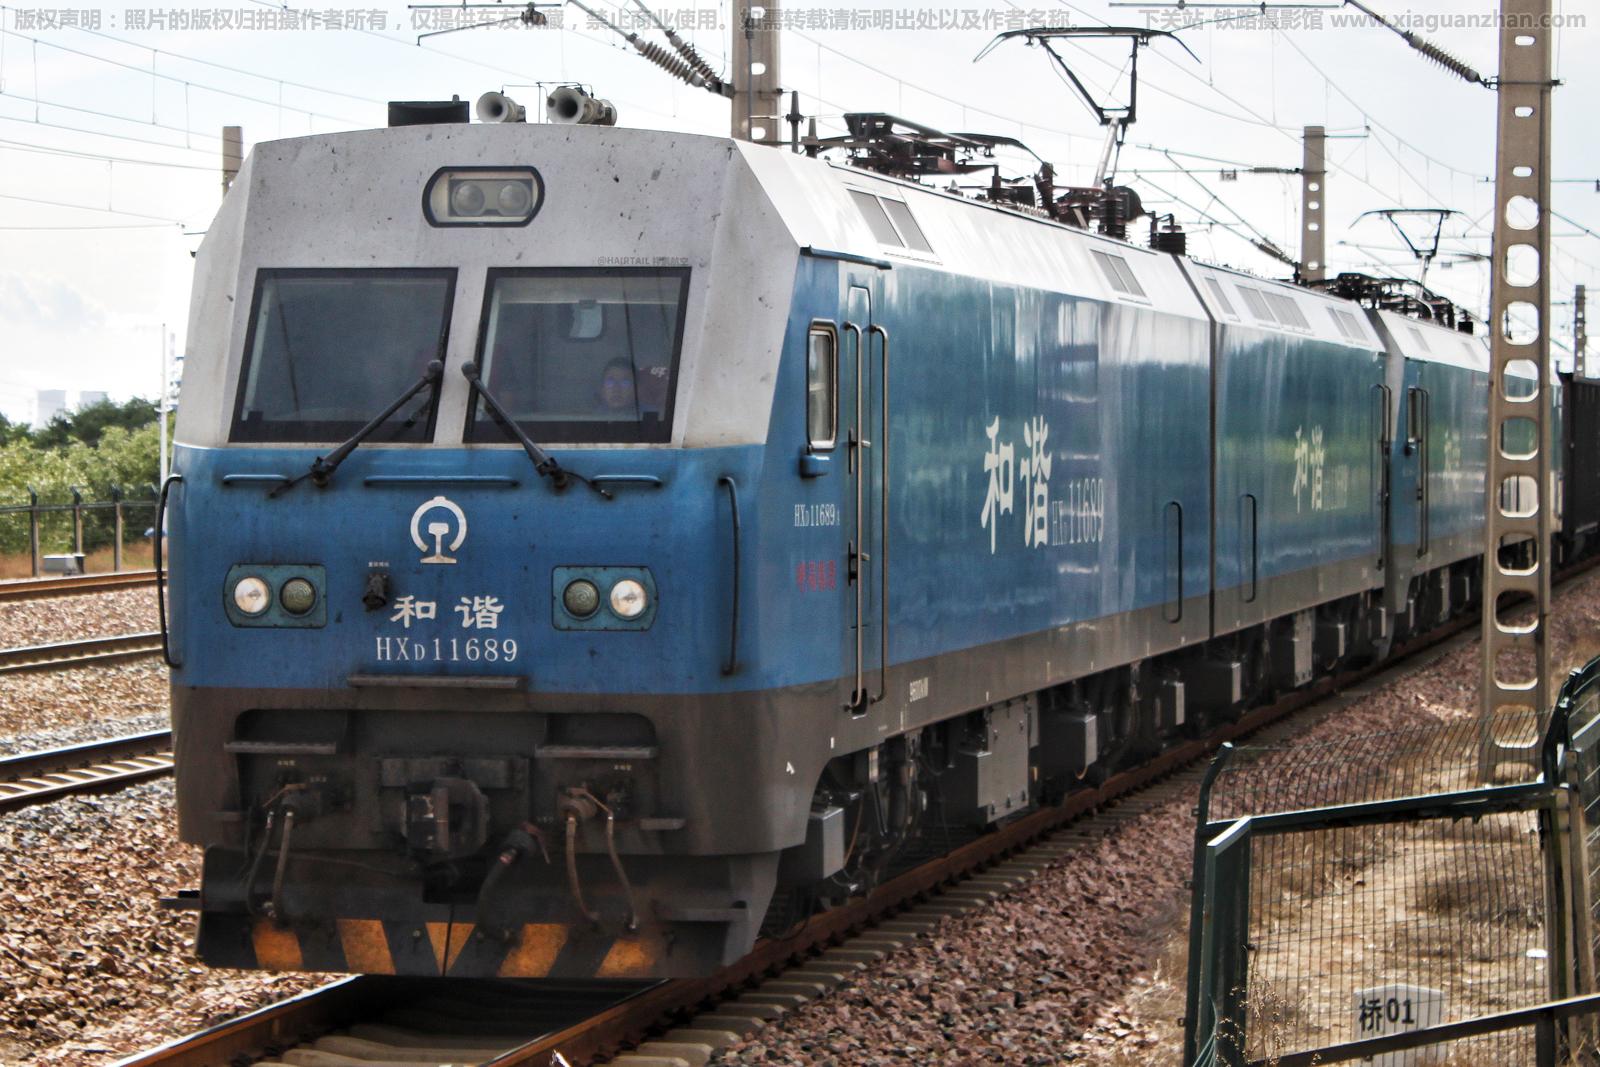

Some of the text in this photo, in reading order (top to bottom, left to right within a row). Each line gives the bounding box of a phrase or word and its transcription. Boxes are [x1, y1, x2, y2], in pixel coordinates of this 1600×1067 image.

[980, 414, 1052, 555] 和谐
[390, 595, 504, 629] 和谐
[376, 637, 518, 662] HXD11689
